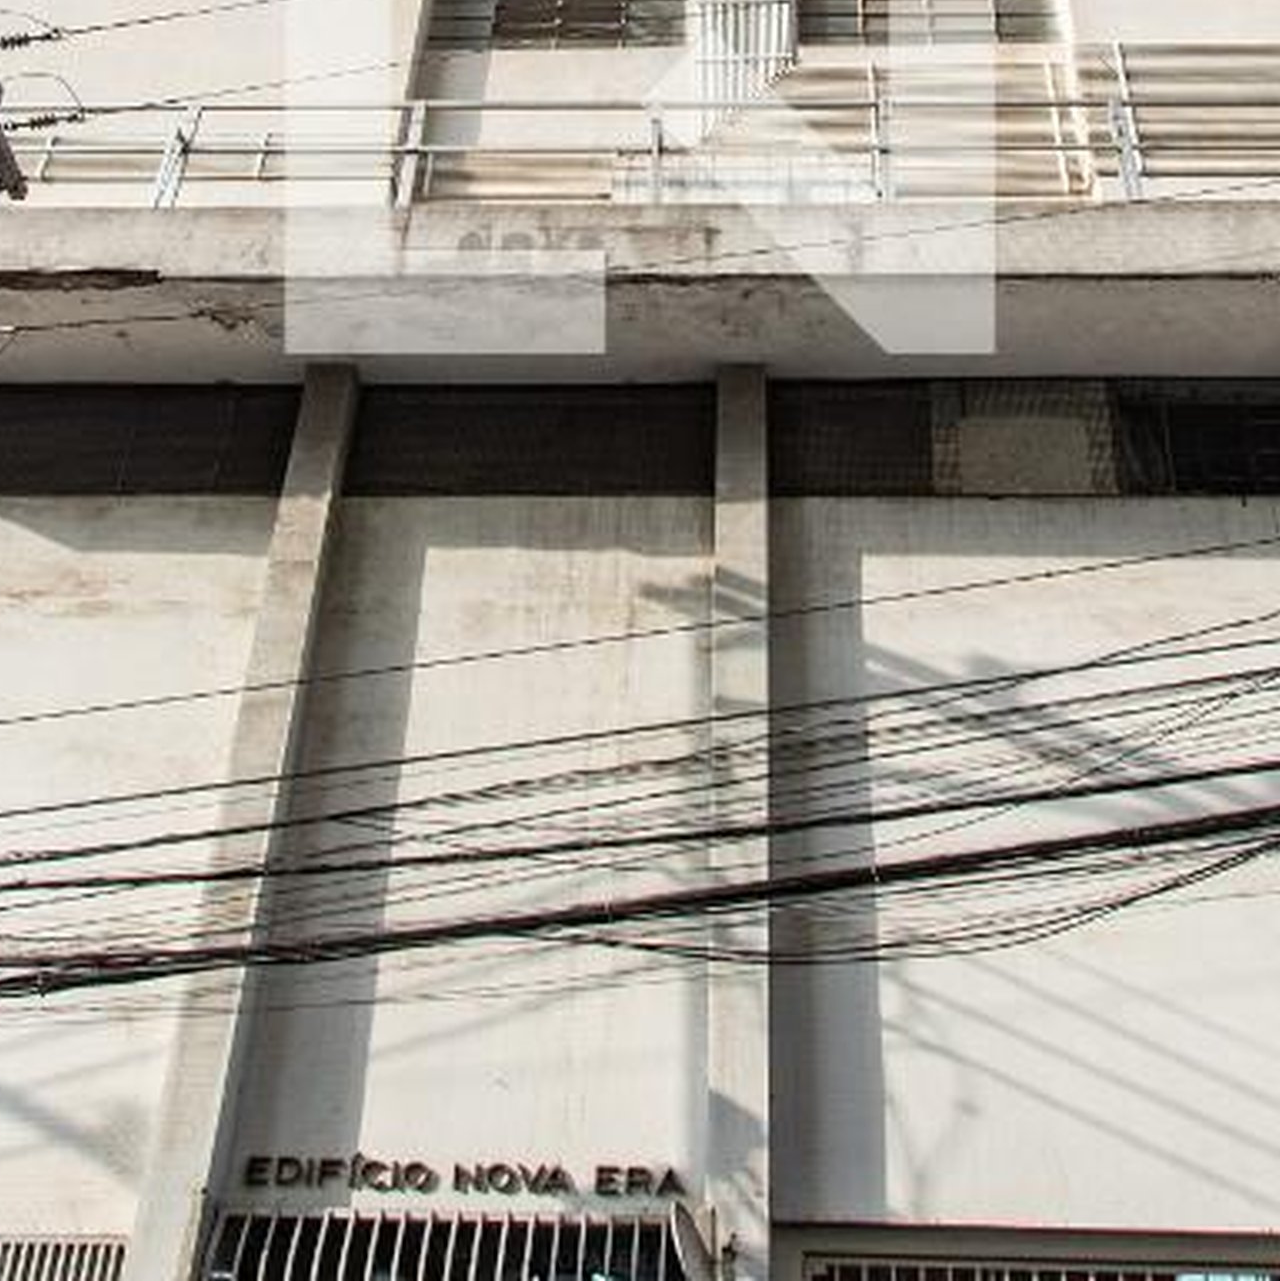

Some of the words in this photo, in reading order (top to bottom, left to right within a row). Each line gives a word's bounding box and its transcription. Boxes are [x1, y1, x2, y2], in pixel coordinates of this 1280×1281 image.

[243, 1153, 439, 1193] EDIFÍCIO
[453, 1162, 575, 1195] NOVA
[594, 1165, 687, 1197] ERA
